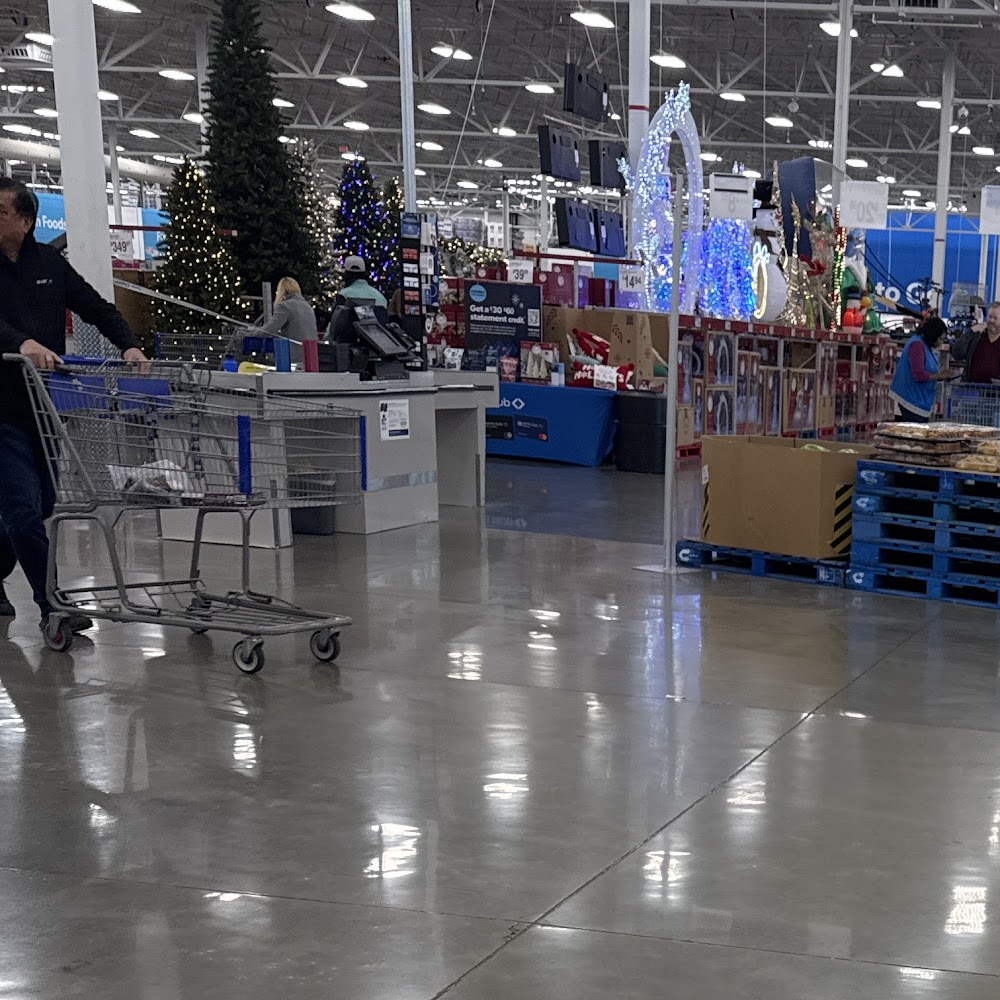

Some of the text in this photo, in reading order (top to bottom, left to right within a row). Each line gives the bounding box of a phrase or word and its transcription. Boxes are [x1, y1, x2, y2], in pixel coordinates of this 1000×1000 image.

[875, 282, 900, 303] to
[469, 304, 484, 313] Get
[469, 314, 507, 323] statement
